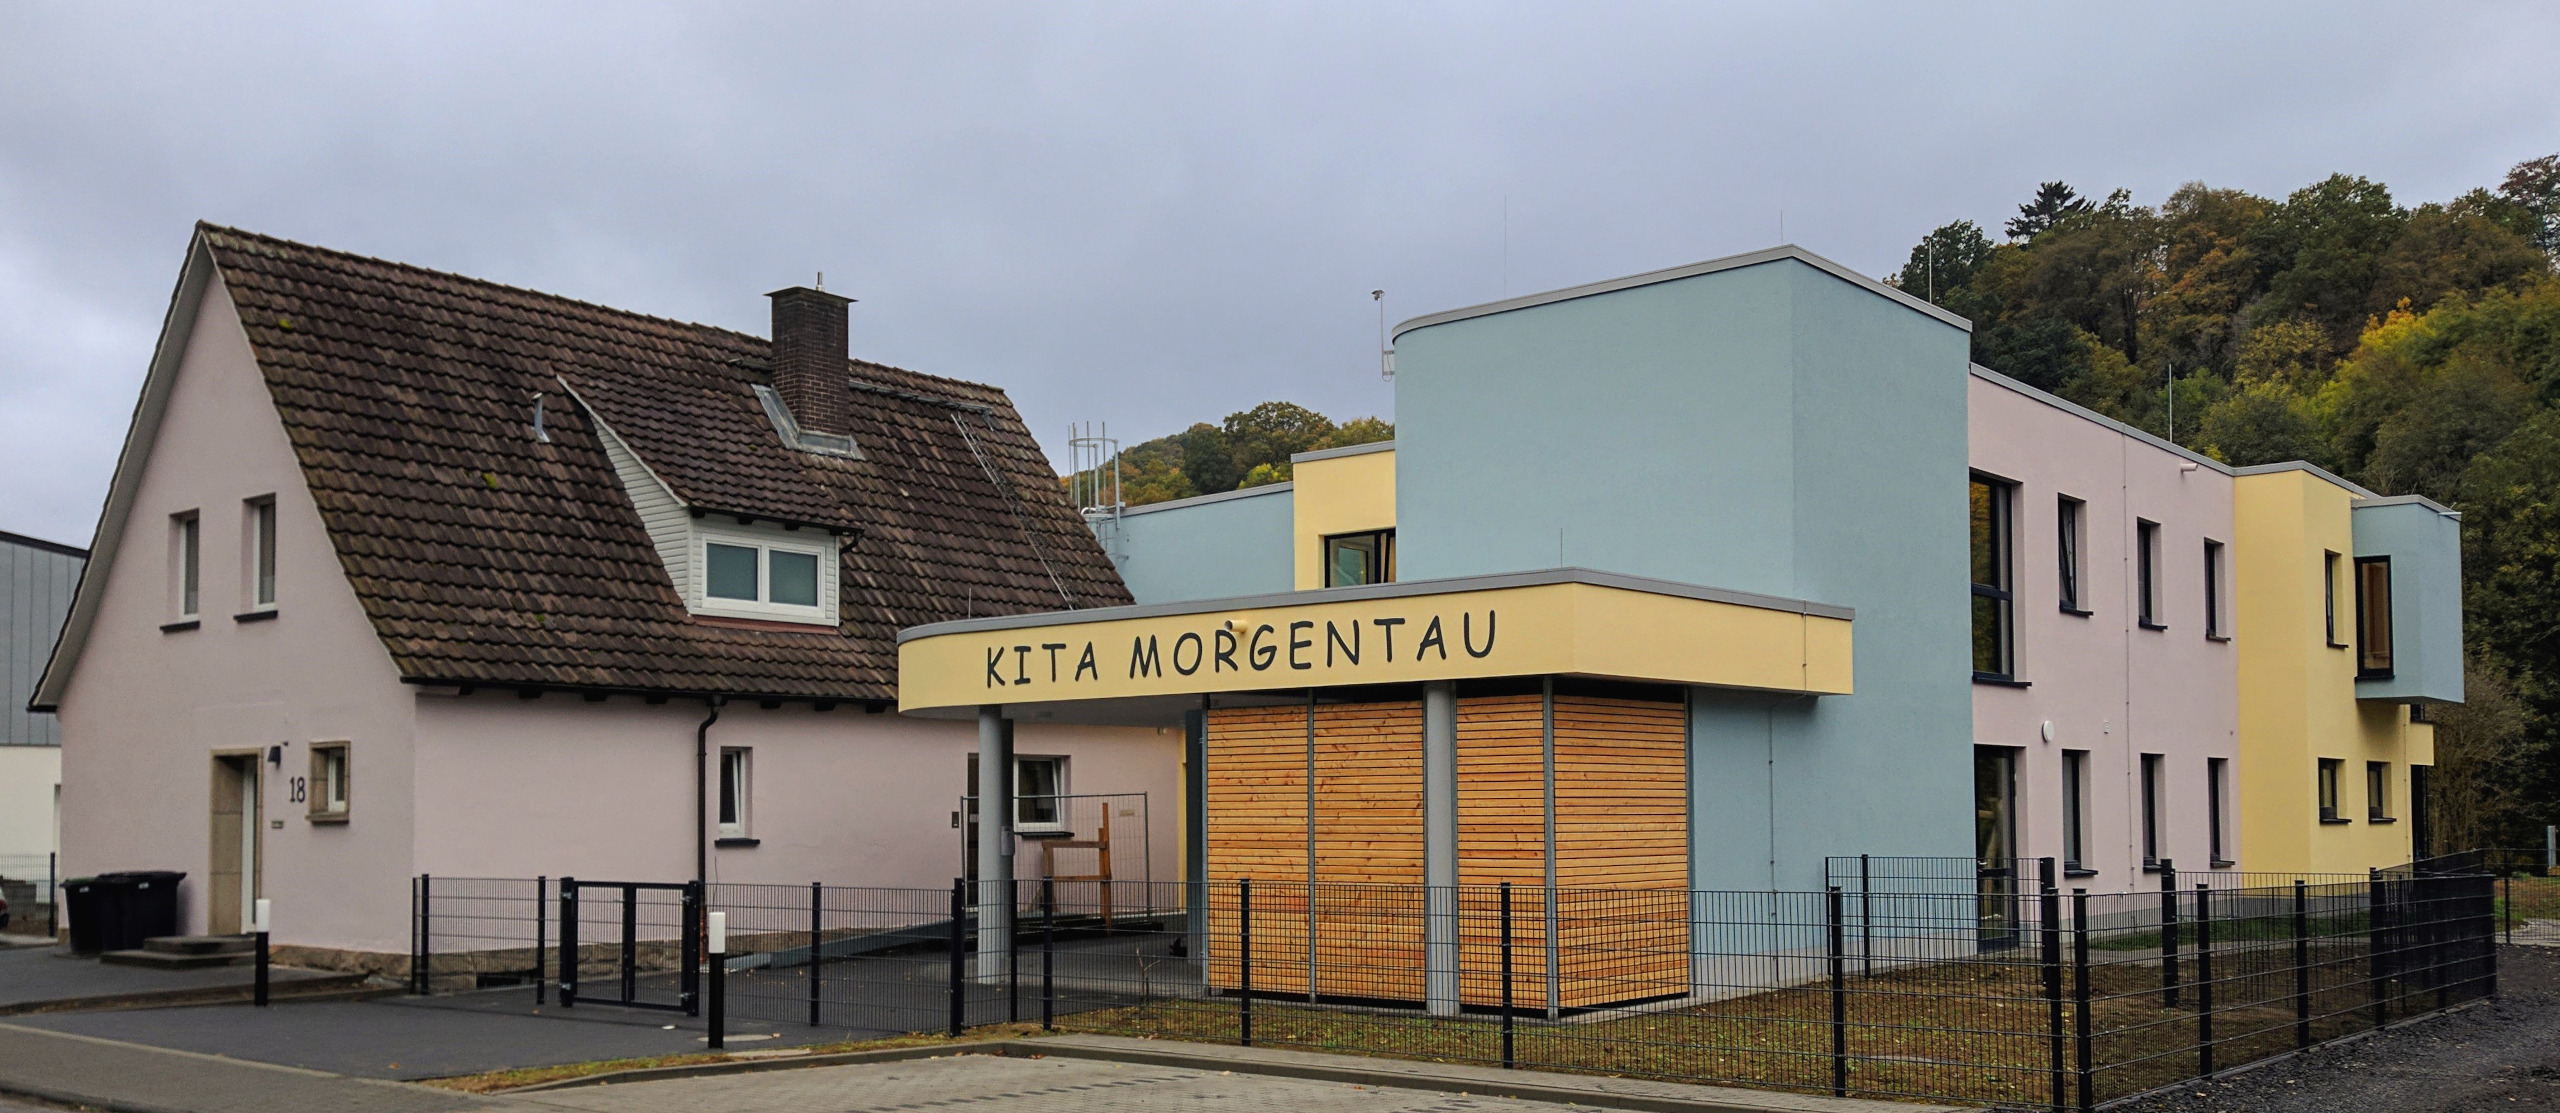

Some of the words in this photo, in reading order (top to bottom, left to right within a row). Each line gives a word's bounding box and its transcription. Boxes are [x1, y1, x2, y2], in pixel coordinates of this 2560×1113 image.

[986, 641, 1098, 688] KITA
[1129, 610, 1495, 680] MORGENTAU
[290, 776, 306, 803] 18
